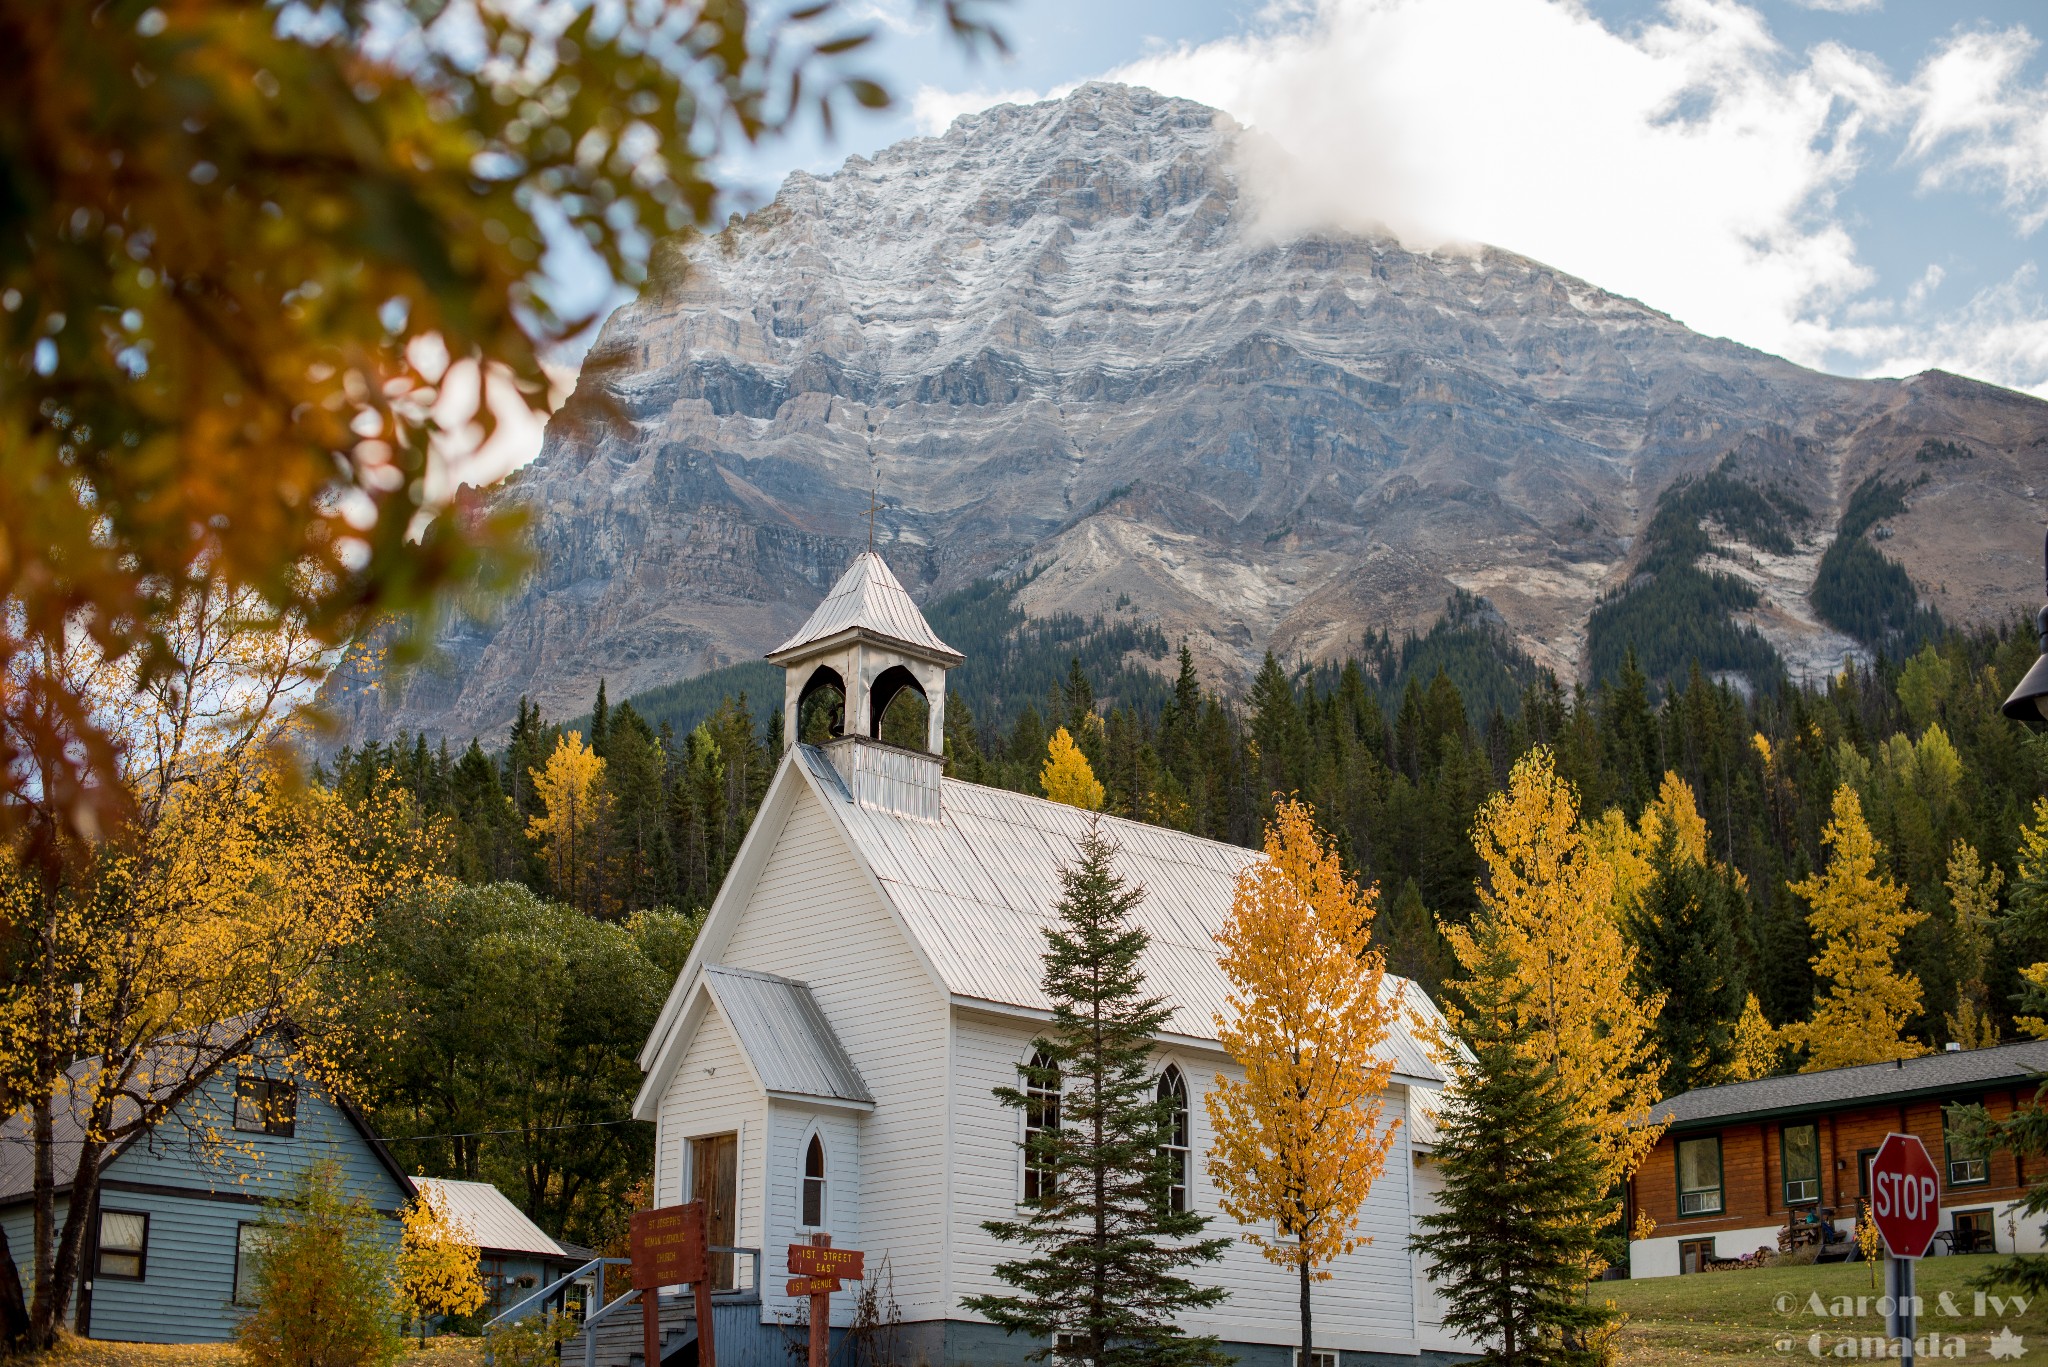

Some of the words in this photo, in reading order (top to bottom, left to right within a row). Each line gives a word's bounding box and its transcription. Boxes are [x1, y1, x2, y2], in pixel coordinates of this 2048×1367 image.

[1876, 1171, 1935, 1220] STOP
[662, 1232, 686, 1245] CATHOLIC
[656, 1251, 676, 1263] CHURCH
[823, 1251, 852, 1263] STREET
[816, 1262, 836, 1273] EAST
[810, 1278, 832, 1290] AVENUE
